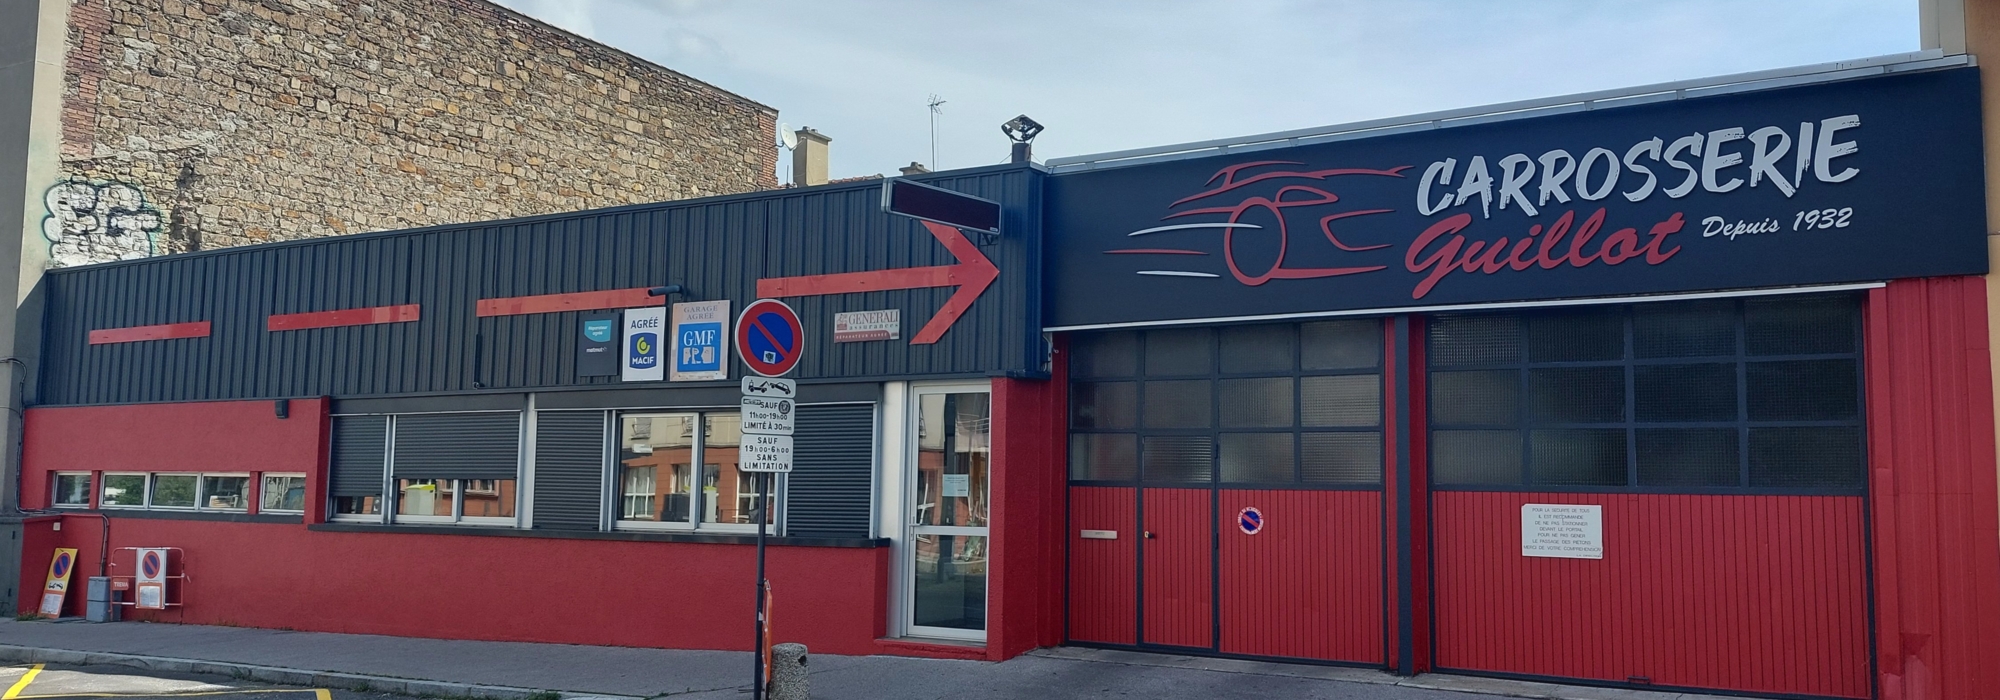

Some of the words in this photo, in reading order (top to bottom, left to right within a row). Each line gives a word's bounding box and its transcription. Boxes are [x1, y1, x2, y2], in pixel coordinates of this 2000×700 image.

[1416, 114, 1861, 219] CARROSSERIE
[1701, 216, 1781, 240] Depuis
[1792, 207, 1854, 231] 1932
[1404, 207, 1686, 300] Guillot
[683, 305, 718, 313] GARAGE
[849, 311, 898, 325] GENERALI
[630, 317, 659, 329] AGRÉÉ
[683, 330, 716, 347] GMF
[632, 356, 654, 365] MACIF
[760, 401, 778, 409] SAUF
[749, 411, 787, 420] 11h00-19h00
[744, 421, 766, 430] LIMITÉ
[768, 421, 773, 430] À
[757, 437, 778, 445] SAUF
[745, 445, 789, 453] 19h00-6h00
[744, 462, 789, 470] LIMITATION
